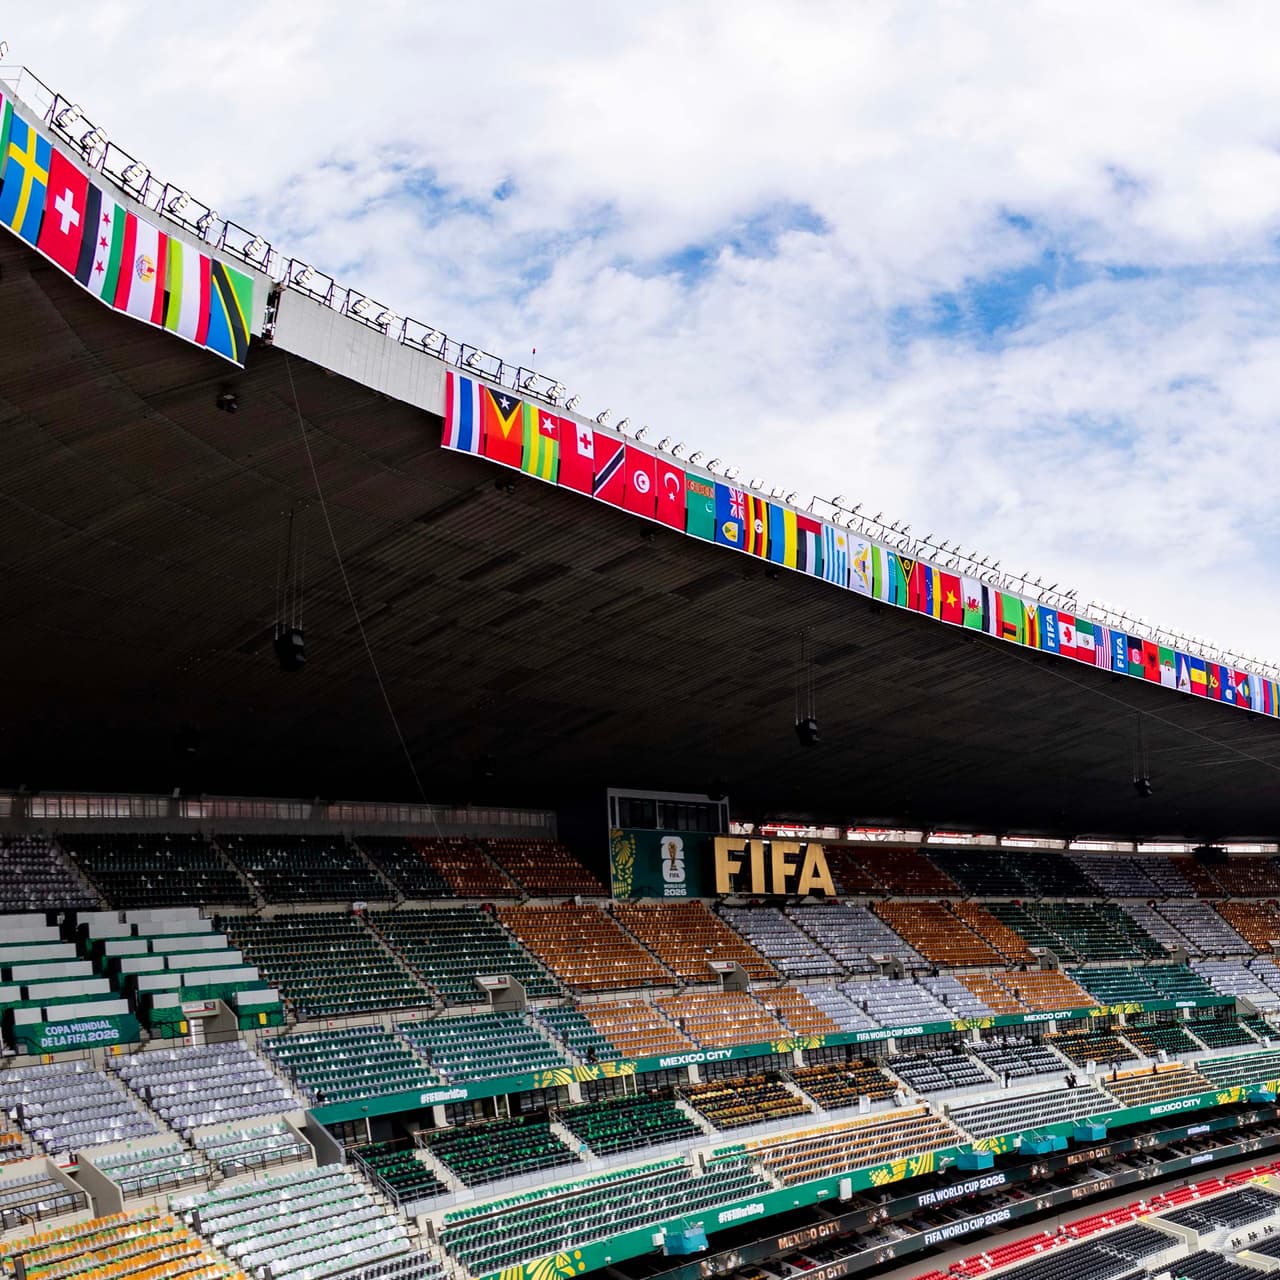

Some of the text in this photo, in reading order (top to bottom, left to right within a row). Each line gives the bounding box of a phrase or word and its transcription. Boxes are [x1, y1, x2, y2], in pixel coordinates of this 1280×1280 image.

[1046, 614, 1055, 647] FIFA
[1116, 637, 1124, 668] FIFA
[714, 836, 836, 896] FIFA
[1023, 1010, 1073, 1022] MEXICO CITY
[45, 1019, 112, 1036] COPA MUNDIAL
[857, 1026, 923, 1041] FIFA WORLD CUP 2026
[41, 1029, 120, 1047] DE LA FIFA 2026
[660, 1049, 732, 1068] MEXICO CITY
[1150, 1097, 1202, 1116] MEXICO CITY
[918, 1173, 1005, 1206] FIFA WORLD CUP 2026
[777, 1221, 841, 1249] MEXICO CITY
